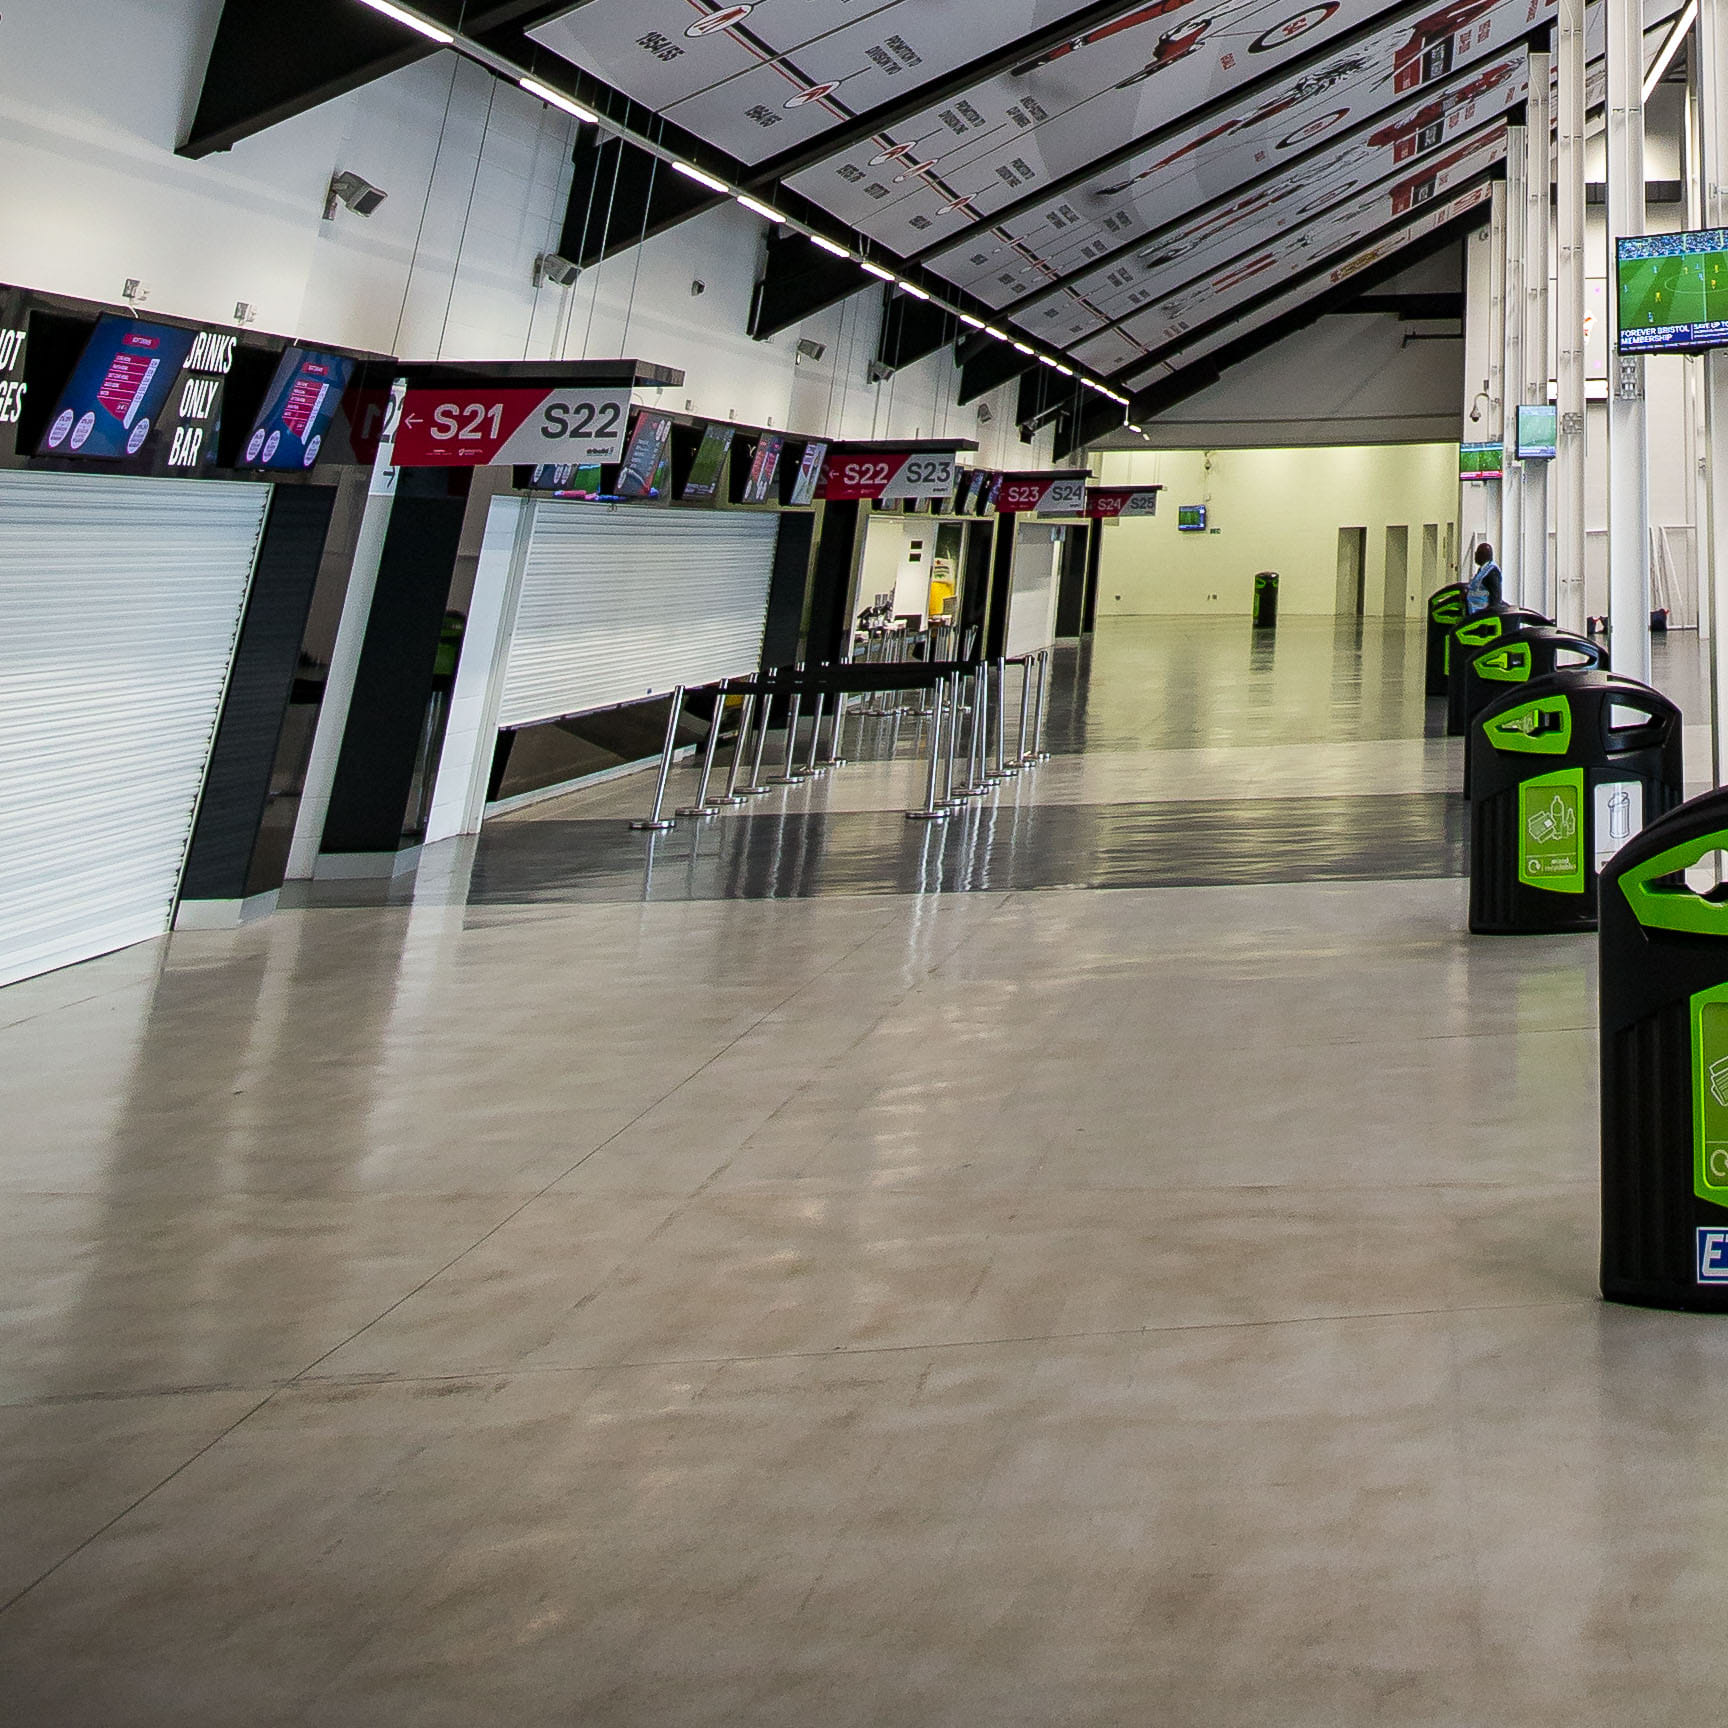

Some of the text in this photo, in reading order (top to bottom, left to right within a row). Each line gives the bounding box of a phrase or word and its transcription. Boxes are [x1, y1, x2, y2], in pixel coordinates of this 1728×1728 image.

[1621, 328, 1657, 337] FOREVER
[179, 379, 219, 419] ONLY
[430, 403, 504, 440] S21
[540, 402, 622, 439] S22
[168, 427, 203, 466] BAR
[843, 462, 889, 485] S22
[906, 461, 950, 483] S23
[1008, 486, 1040, 502] S23
[1052, 486, 1082, 501] S24
[1097, 498, 1122, 510] S24
[1130, 497, 1154, 509] S25
